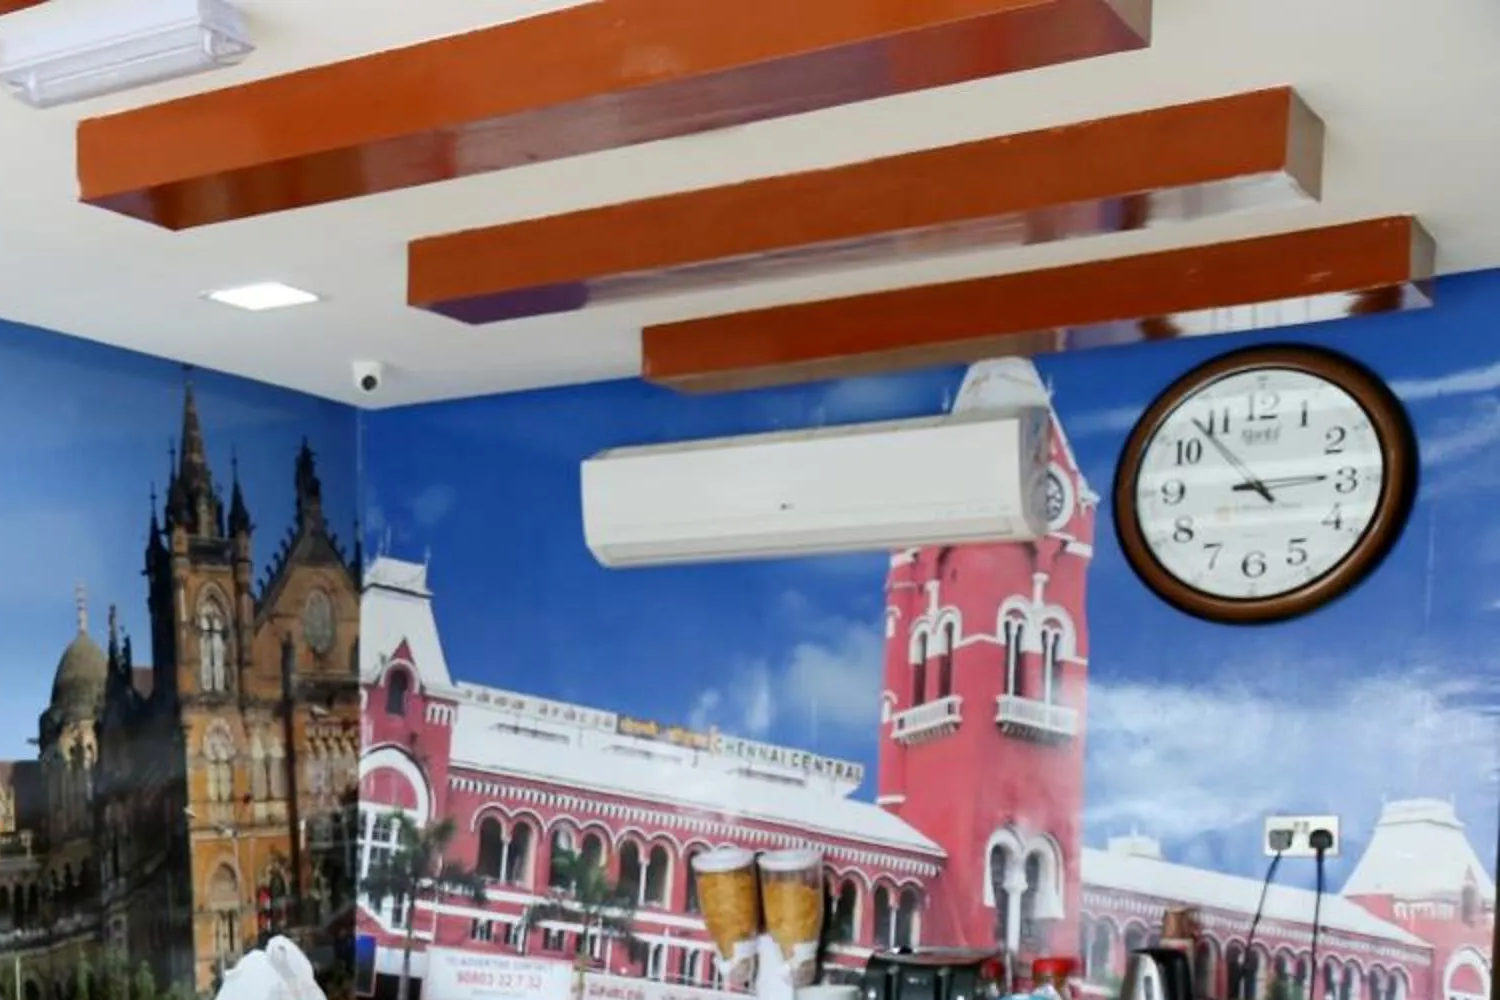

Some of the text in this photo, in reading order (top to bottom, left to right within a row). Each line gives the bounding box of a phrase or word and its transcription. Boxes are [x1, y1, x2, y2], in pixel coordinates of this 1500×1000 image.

[1245, 391, 1281, 421] 12
[1299, 400, 1309, 428] 1
[1207, 408, 1231, 434] 11
[1175, 438, 1204, 466] 10
[1323, 426, 1347, 454] 2
[1160, 479, 1186, 505] 9
[1334, 466, 1359, 494] 3
[1172, 516, 1195, 544] 8
[1322, 503, 1345, 531] 4
[1203, 543, 1224, 570] 7
[1241, 551, 1267, 578] 6
[1286, 538, 1308, 566] 5
[791, 752, 862, 781] CENTRAL
